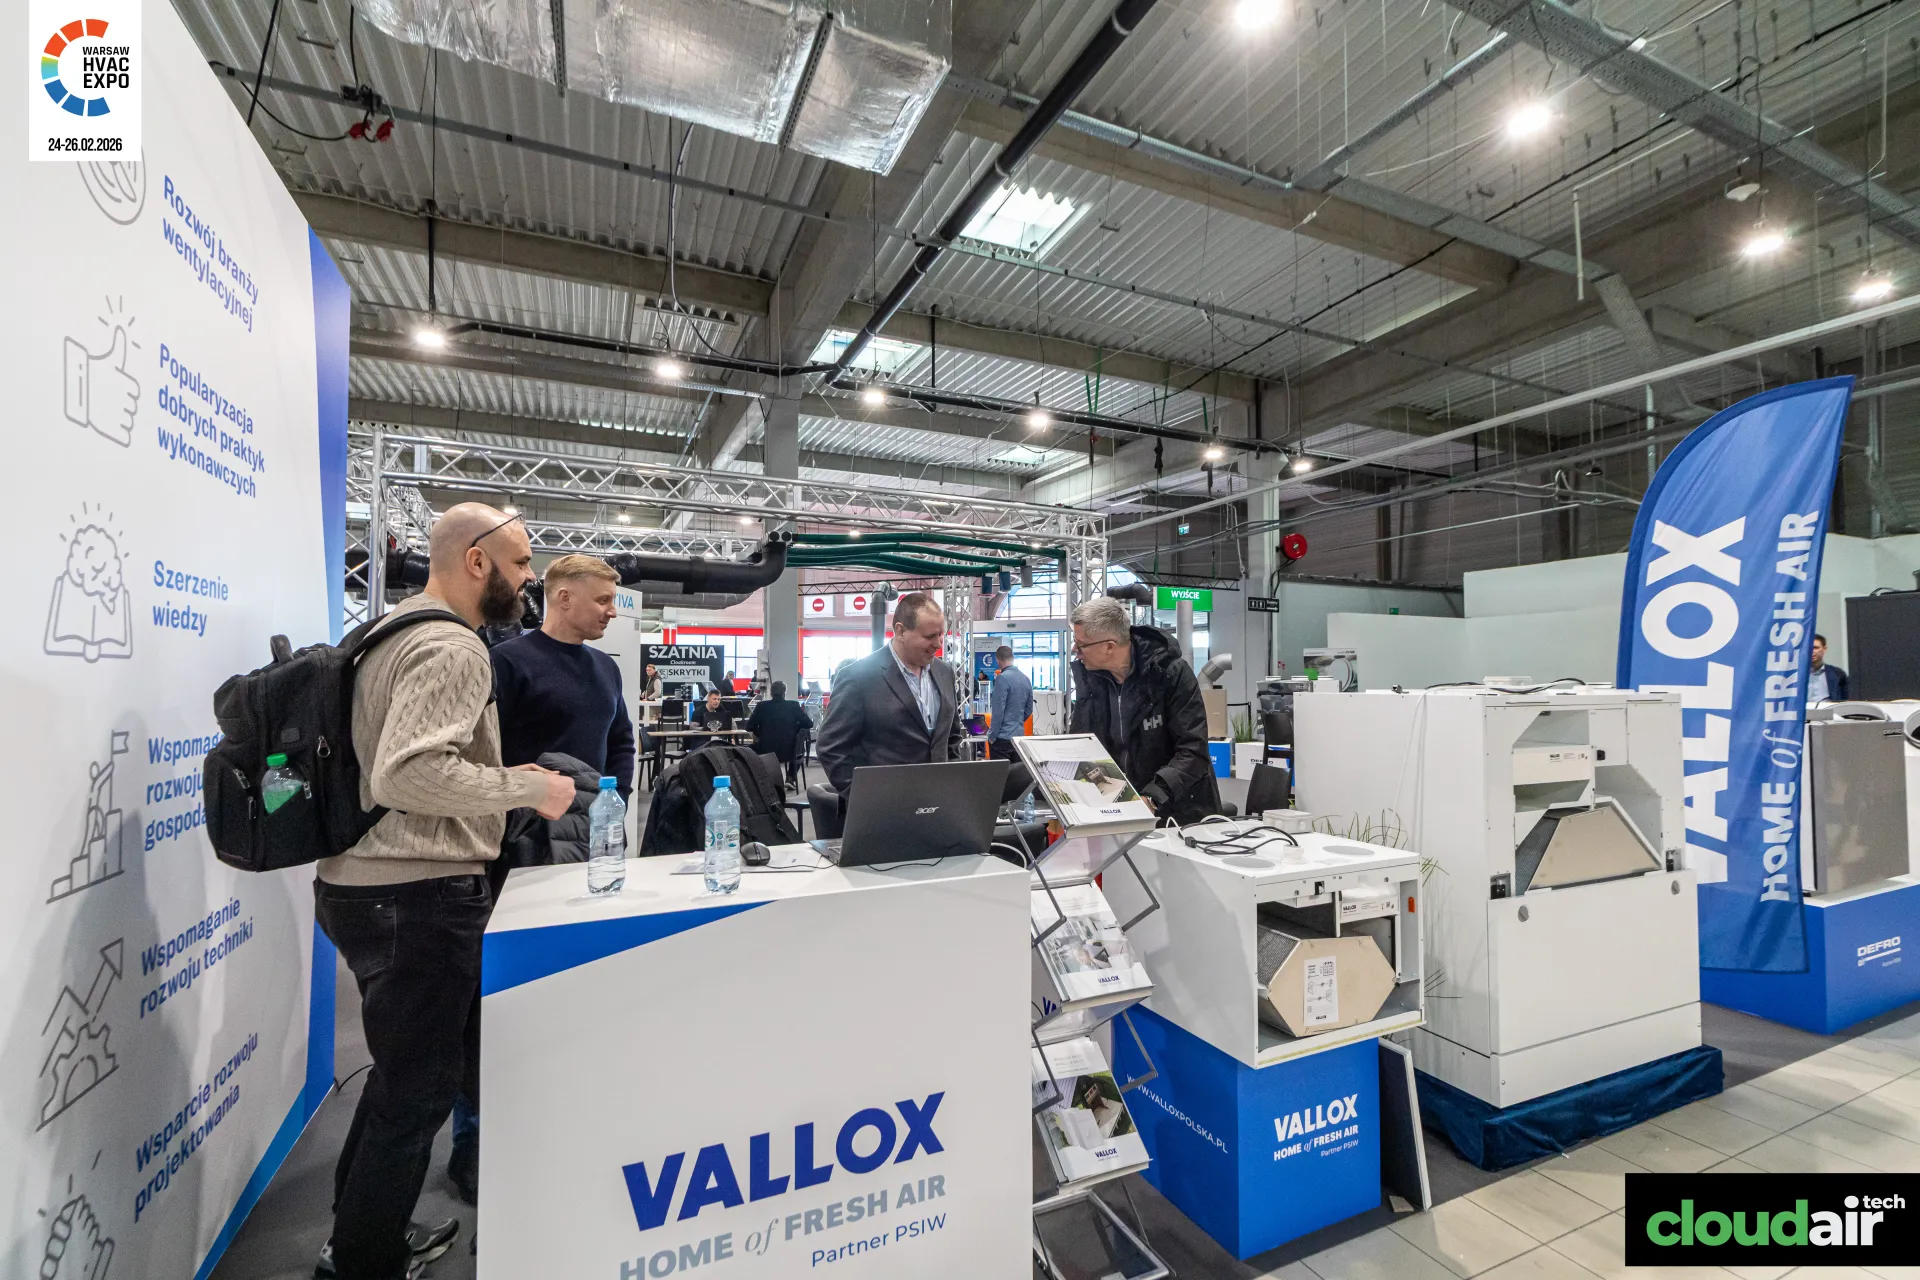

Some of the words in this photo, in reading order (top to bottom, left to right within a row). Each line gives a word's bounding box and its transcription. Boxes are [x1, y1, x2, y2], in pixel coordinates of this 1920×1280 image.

[164, 174, 216, 259] Rozwój
[218, 239, 259, 305] branży
[162, 217, 253, 333] wentylacyjnej
[159, 343, 254, 435] Popularyzacja
[158, 384, 217, 443] dobrych
[220, 430, 265, 473] praktyk
[157, 426, 256, 499] wykonawczych
[1775, 510, 1820, 582] AIR
[153, 559, 229, 601] Szerzenie
[1170, 589, 1200, 600] WYJŚCIE
[152, 600, 208, 637] wiedzy
[648, 645, 718, 659] SZATNIA
[668, 668, 706, 676] SKRYTKI
[1764, 591, 1806, 722] FRESH
[148, 732, 226, 766] Wspomag
[1761, 728, 1803, 770] of
[915, 806, 940, 815] acer
[1760, 781, 1796, 903] HOME
[140, 957, 201, 1020] rozwoju
[203, 915, 253, 970] techniki
[141, 896, 241, 977] Wspomaganie
[1857, 935, 1901, 957] DEFRO
[135, 1082, 211, 1173] Wsparcie
[213, 1031, 259, 1094] rozwoju
[1273, 1093, 1359, 1143] VALLOX
[133, 1083, 240, 1225] projektowania
[621, 1091, 946, 1232] VALLOX
[1094, 1147, 1118, 1158] VALLOX
[1273, 1142, 1303, 1162] HOME
[1303, 1138, 1314, 1152] of
[1313, 1129, 1343, 1148] FRESH
[1343, 1124, 1359, 1138] AIR
[1320, 1145, 1343, 1157] Partner
[1343, 1138, 1359, 1150] PSIW
[619, 1232, 735, 1280] HOME
[745, 1218, 779, 1256] of
[784, 1189, 888, 1241] FRESH
[896, 1174, 947, 1209] AIR
[811, 1232, 890, 1268] Partner
[895, 1212, 947, 1242] PSIW
